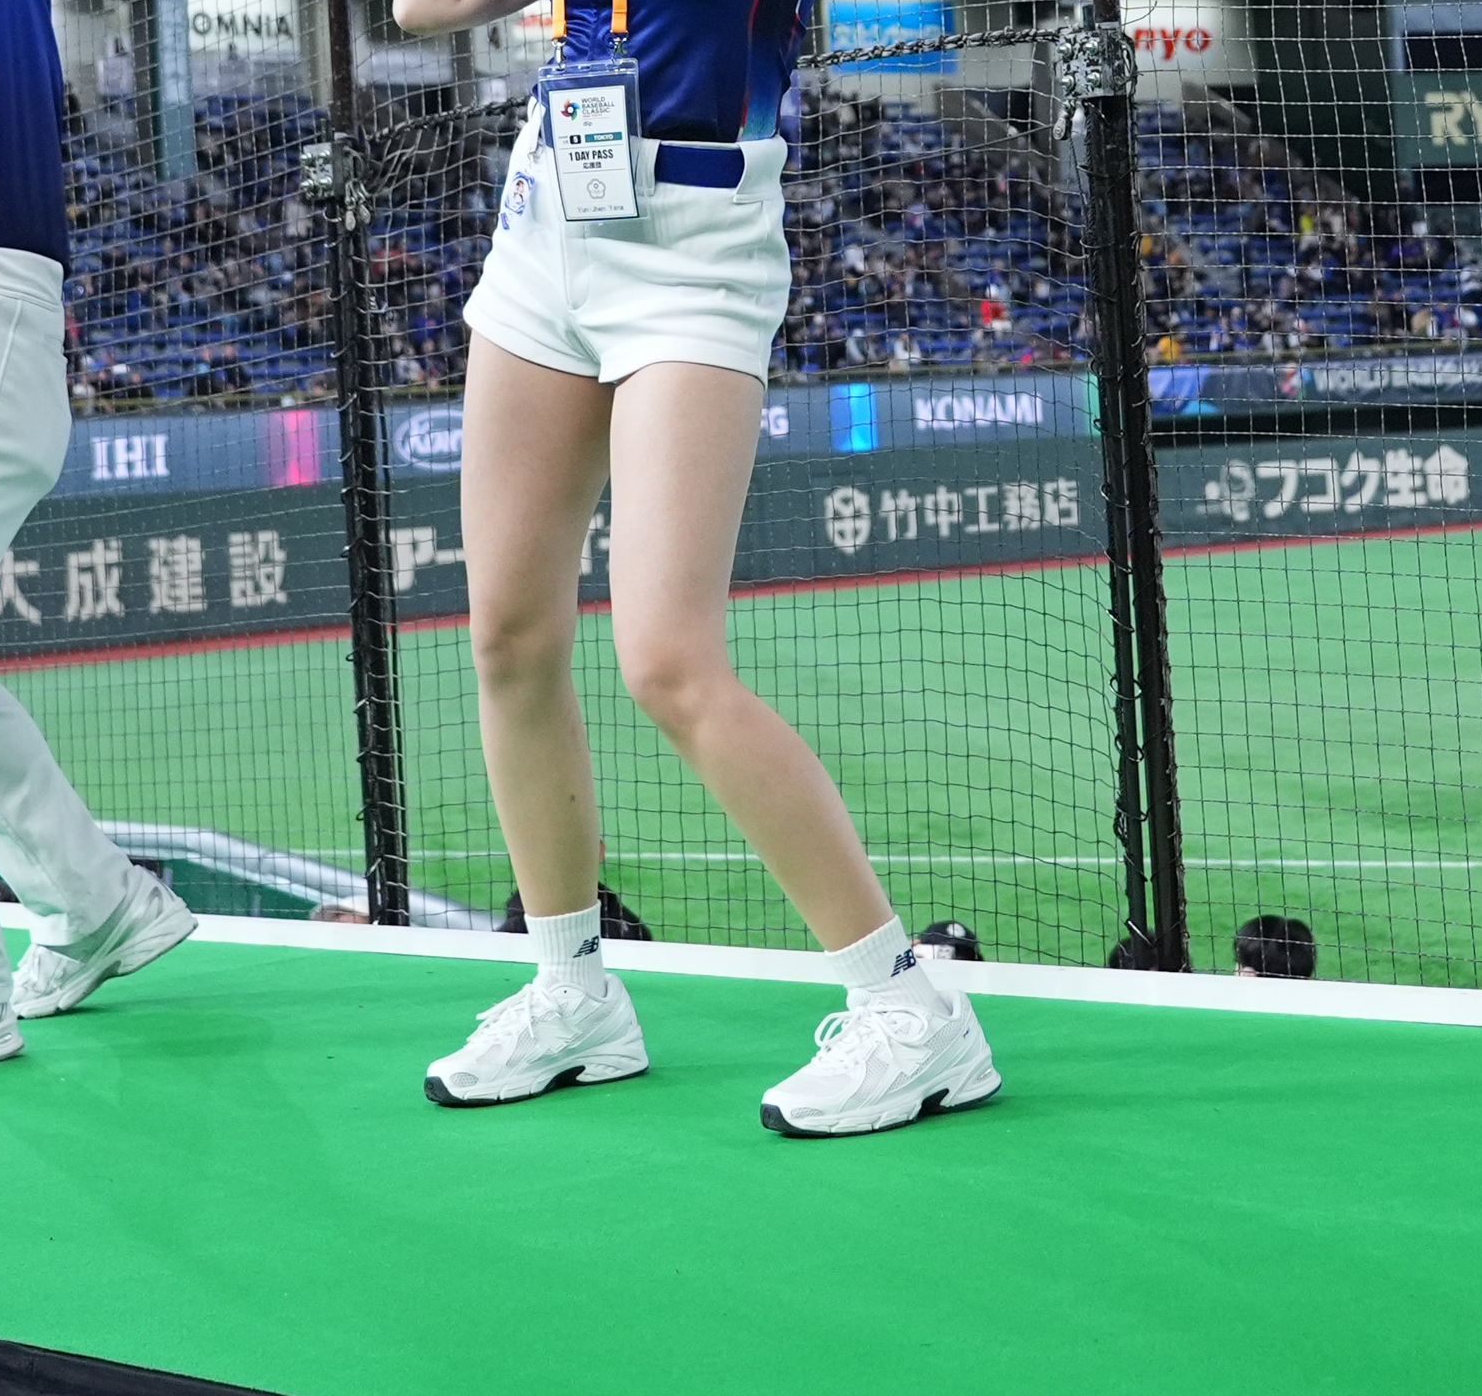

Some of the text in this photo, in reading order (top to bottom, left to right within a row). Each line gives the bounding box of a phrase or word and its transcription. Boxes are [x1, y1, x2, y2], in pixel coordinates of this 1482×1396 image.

[192, 11, 294, 39] OMNIA
[1133, 27, 1212, 60] nyo
[575, 151, 590, 161] DAY
[592, 149, 614, 159] PASS
[91, 433, 170, 481] IHI
[1257, 443, 1471, 519] フコク生命
[879, 477, 1080, 540] 竹中工務店
